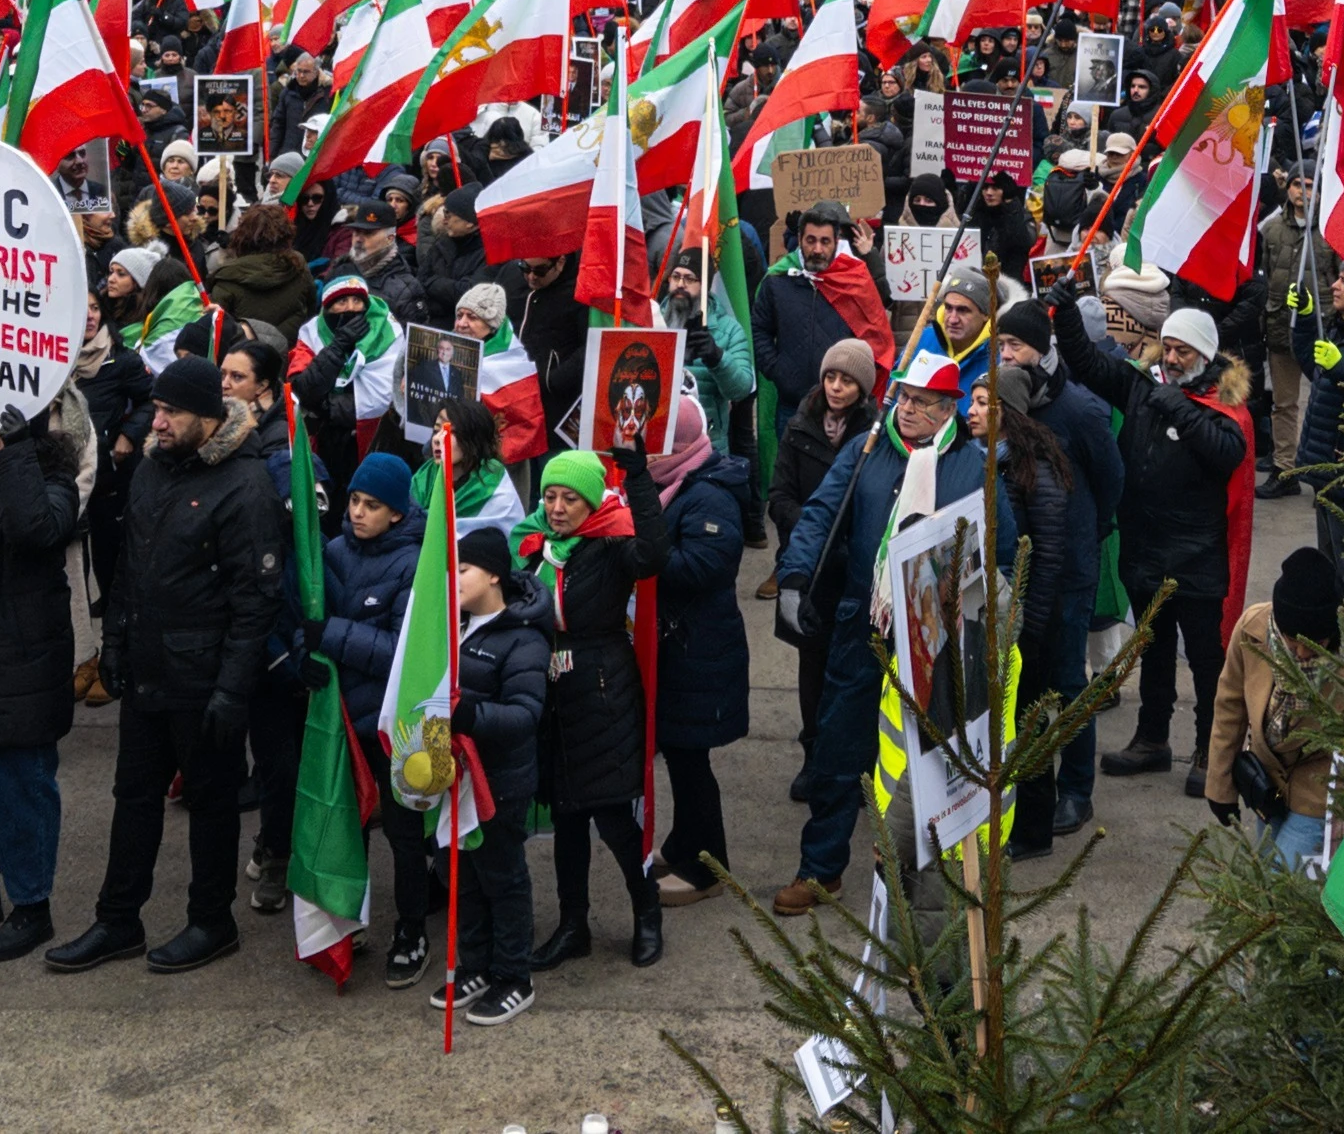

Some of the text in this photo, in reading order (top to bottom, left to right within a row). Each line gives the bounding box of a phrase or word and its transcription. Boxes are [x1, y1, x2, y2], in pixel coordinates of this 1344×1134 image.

[952, 98, 1023, 112] ALL EYES ON IRN
[952, 111, 972, 120] STOP
[957, 124, 967, 132] BE
[969, 126, 992, 135] THEIR
[947, 142, 964, 150] ALLA
[999, 145, 1009, 155] PÅ
[1010, 148, 1029, 157] IRAN
[777, 153, 790, 171] IF
[916, 152, 938, 162] VÅRA
[952, 154, 975, 163] STOPP
[957, 167, 972, 175] VAR
[887, 231, 954, 263] FREE
